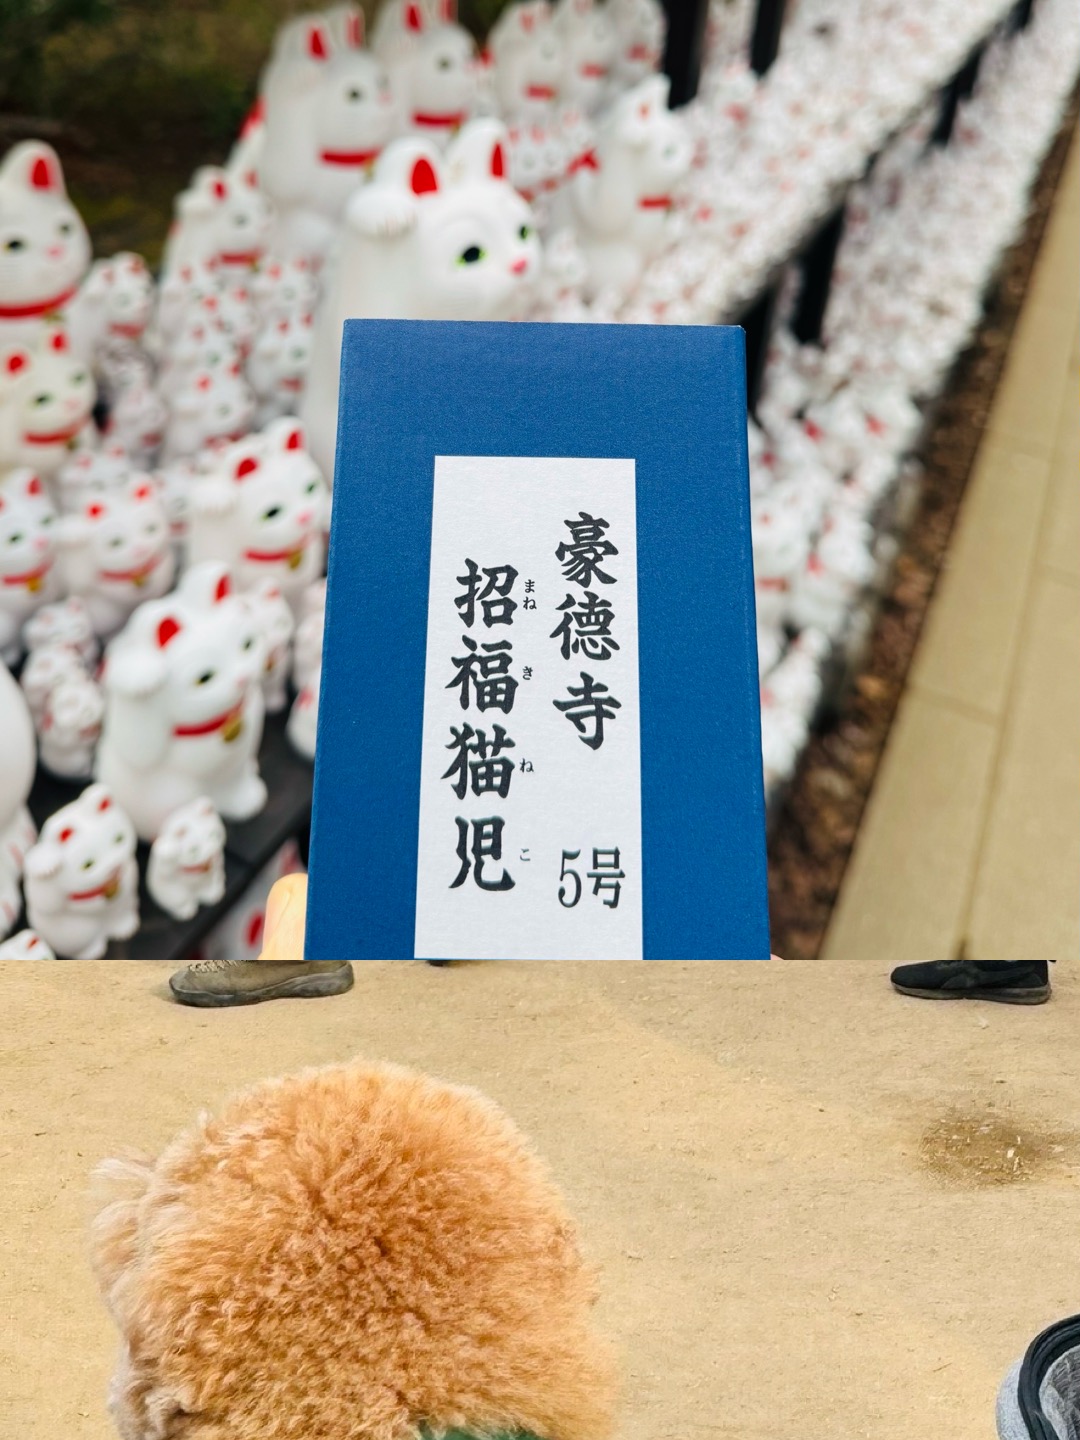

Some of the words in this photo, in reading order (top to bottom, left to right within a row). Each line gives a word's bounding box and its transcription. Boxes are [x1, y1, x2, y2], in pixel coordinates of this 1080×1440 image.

[441, 558, 518, 892] 招福猫児
[558, 846, 627, 909] 5号
